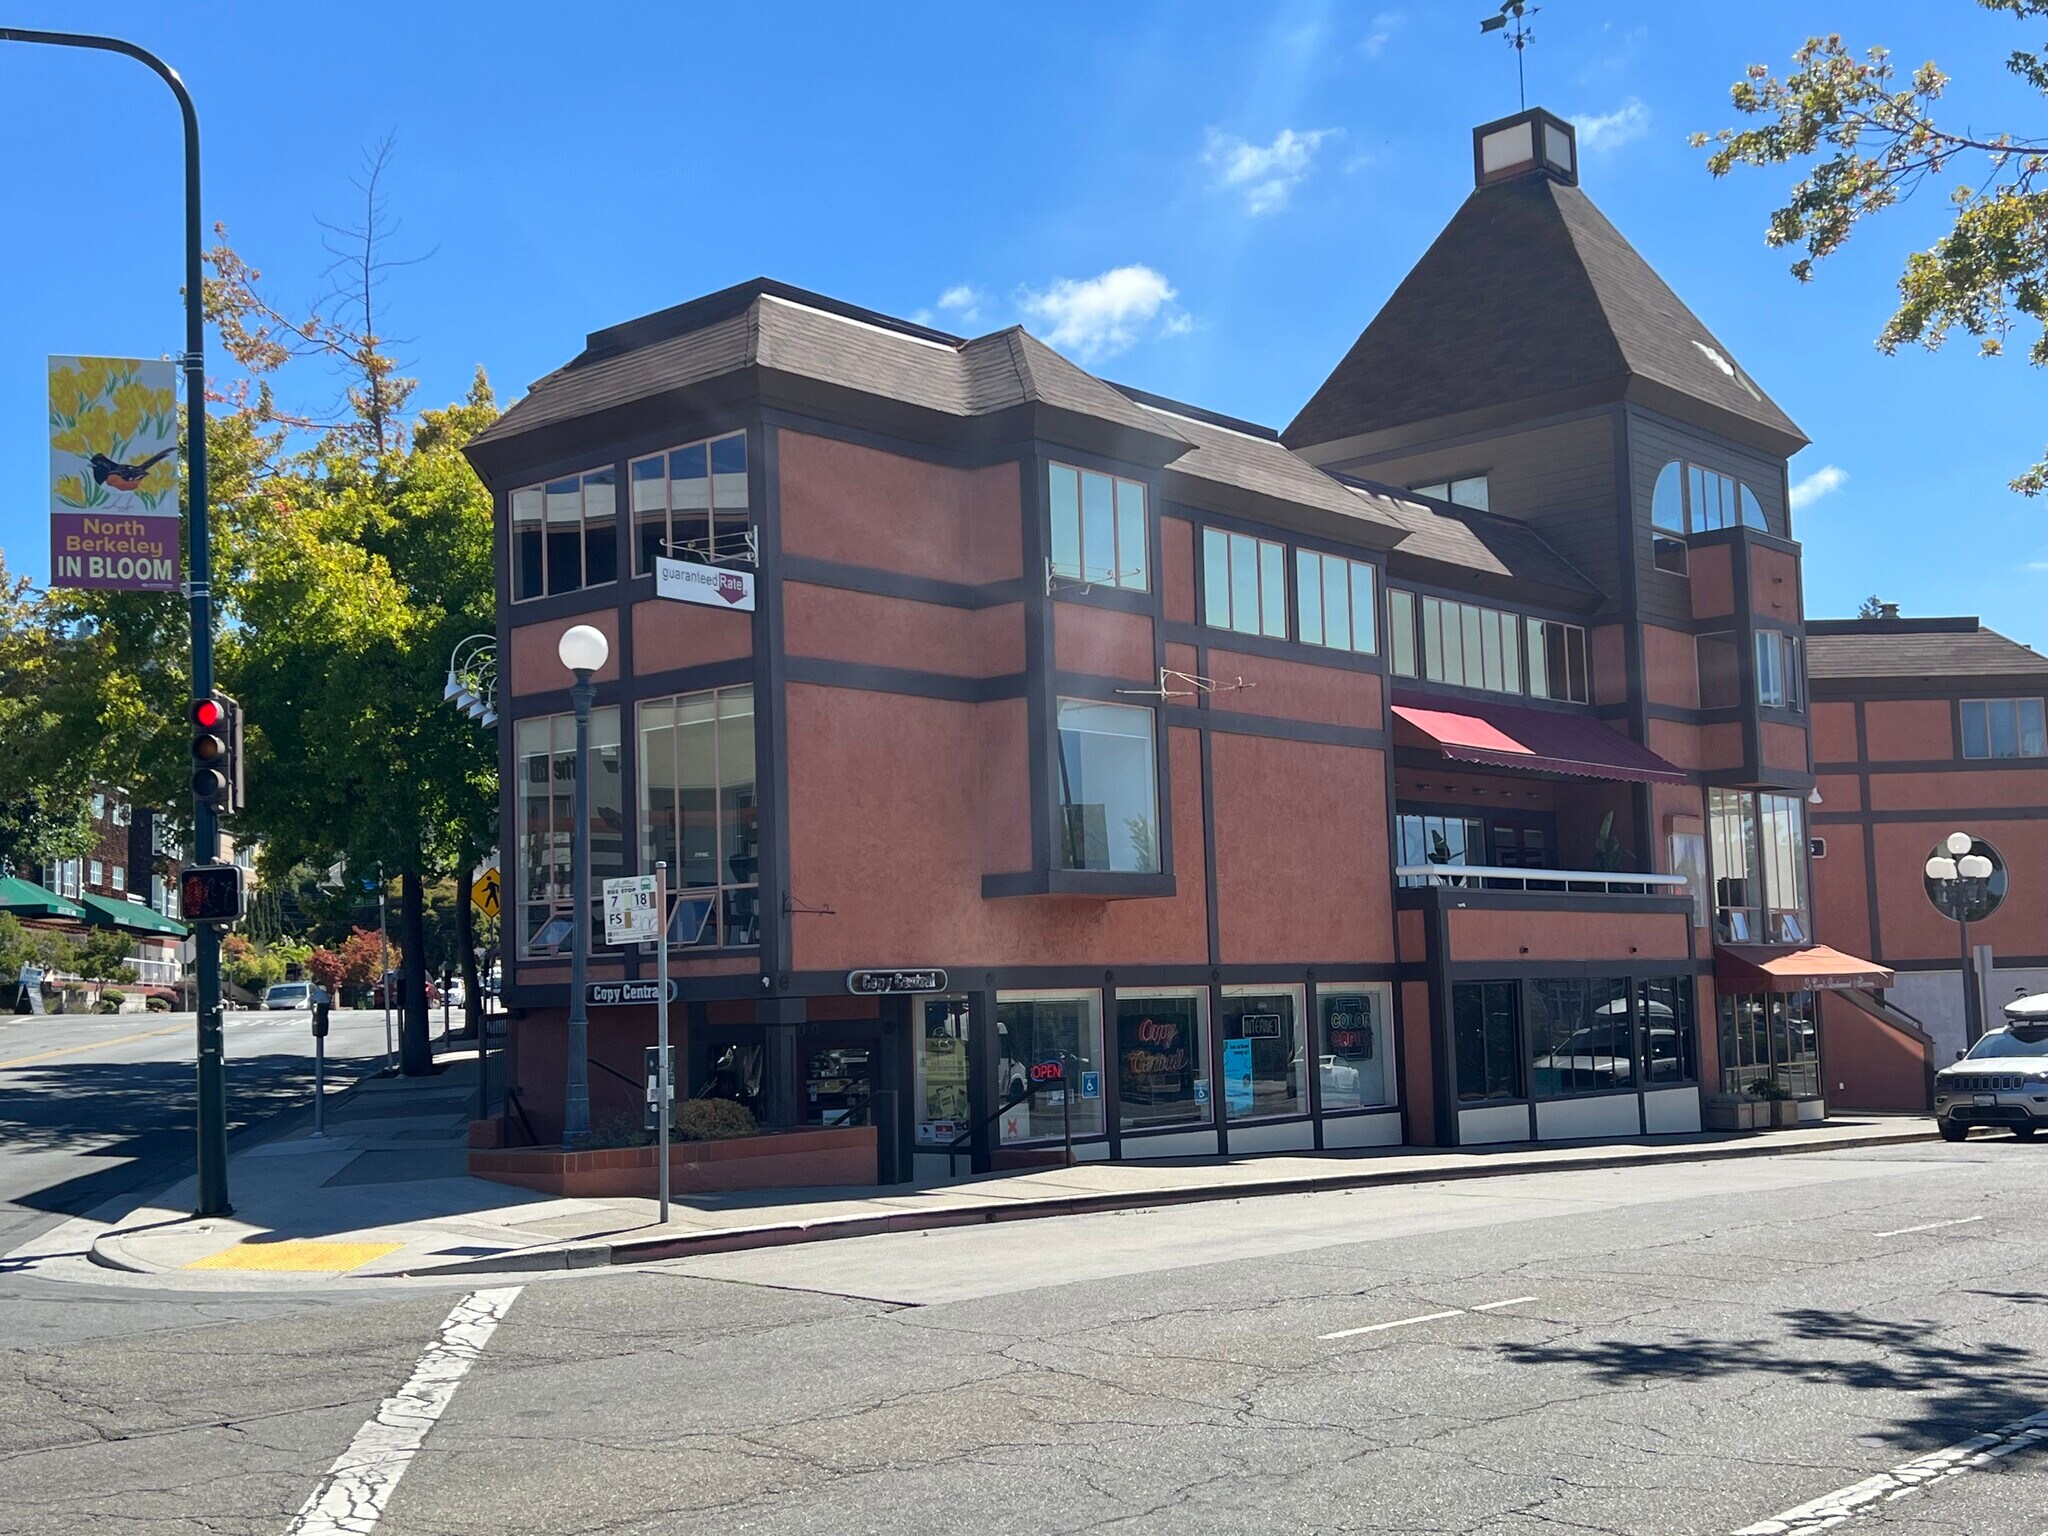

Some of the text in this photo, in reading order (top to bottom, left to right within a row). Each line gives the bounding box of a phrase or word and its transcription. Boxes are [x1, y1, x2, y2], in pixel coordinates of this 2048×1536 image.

[83, 518, 145, 536] North
[66, 535, 163, 557] Berkeley
[58, 556, 172, 580] IN BLOOM
[662, 567, 743, 591] guaranteed Rate
[611, 896, 618, 907] 7
[635, 893, 647, 905] 18
[610, 913, 622, 924] FS
[594, 984, 660, 1003] Copy Centra
[1331, 1012, 1371, 1029] COLOR
[1139, 1018, 1178, 1048] Copy
[1031, 1063, 1062, 1079] OPEN
